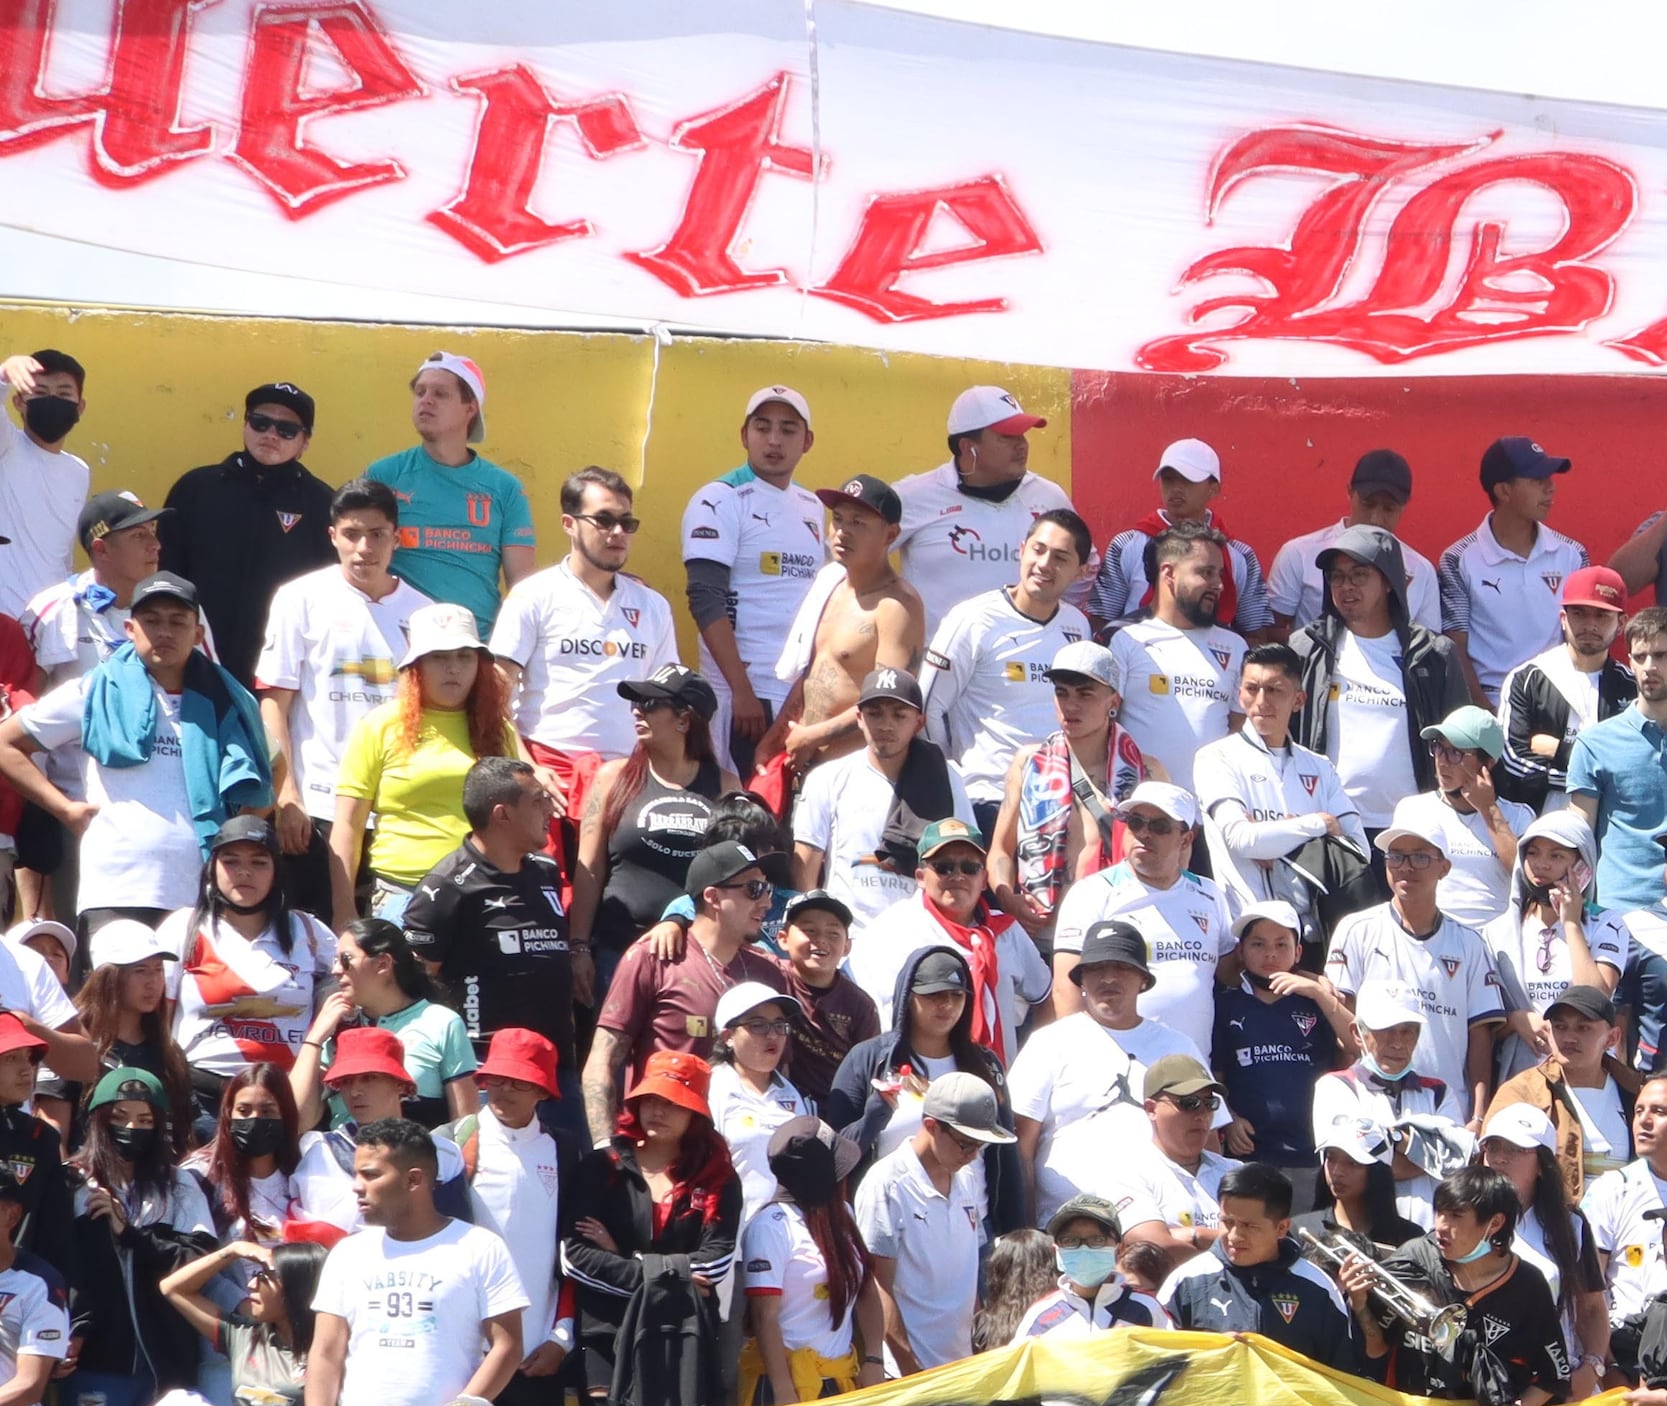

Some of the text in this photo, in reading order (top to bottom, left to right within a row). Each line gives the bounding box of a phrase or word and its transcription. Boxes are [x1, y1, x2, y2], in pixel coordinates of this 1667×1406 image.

[424, 527, 472, 540] BANCO
[424, 540, 493, 553] PICHINCHA
[781, 553, 814, 566] BANCO
[560, 638, 647, 660] DISCOVER
[1174, 676, 1214, 688] BANCO
[522, 929, 558, 940] BANCO
[1156, 940, 1202, 951] BANCO
[1528, 981, 1569, 991] BANCO
[1254, 1045, 1290, 1056] BANCO
[364, 1270, 441, 1291] VARSITY
[387, 1292, 413, 1317] 93
